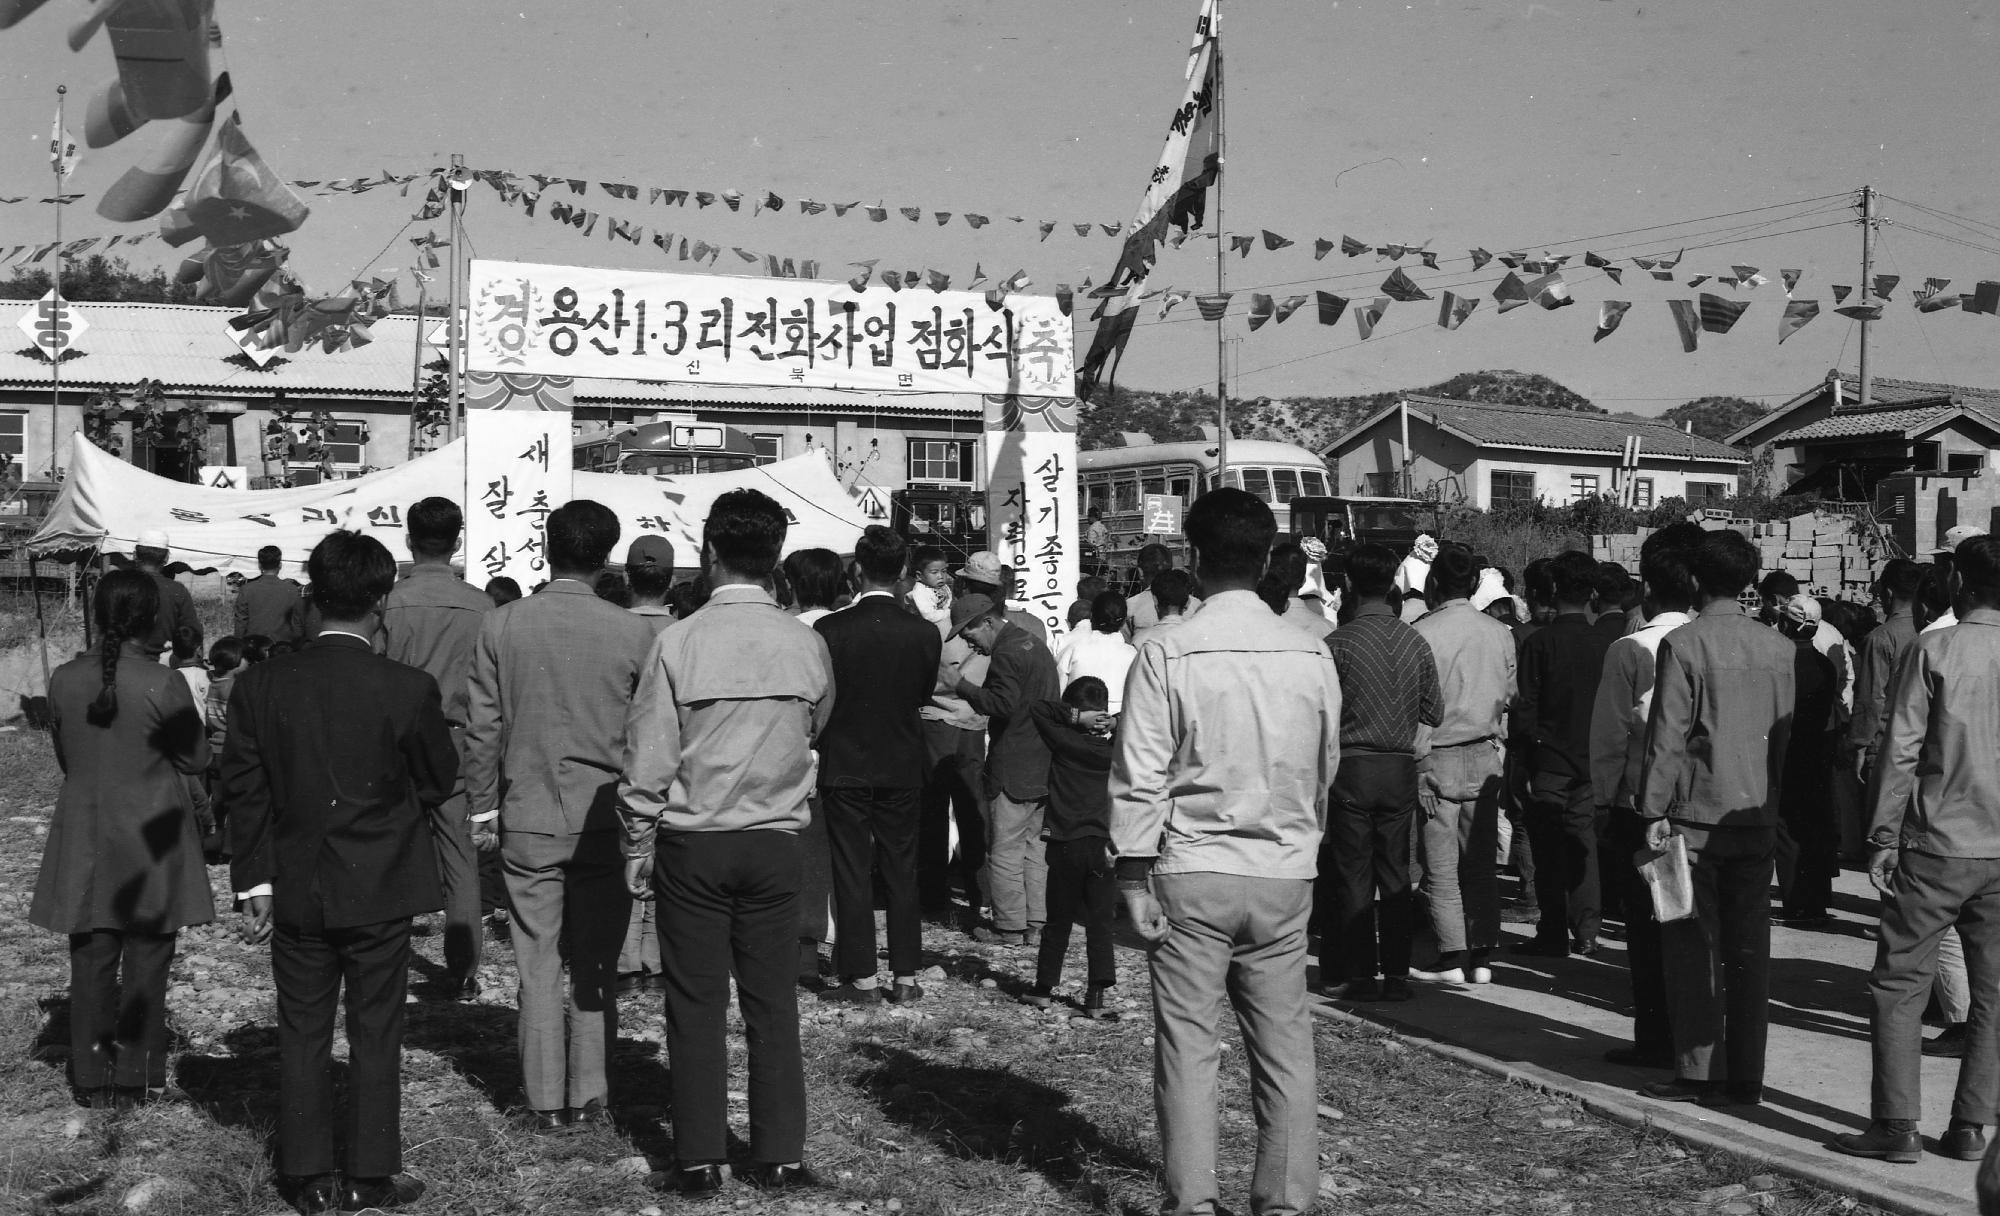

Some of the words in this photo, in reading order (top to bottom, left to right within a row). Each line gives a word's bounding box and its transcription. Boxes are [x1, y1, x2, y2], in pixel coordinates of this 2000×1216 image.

[907, 305, 1013, 379] 점화식
[1020, 320, 1064, 382] 축
[517, 433, 549, 473] 새
[515, 490, 551, 591] 춘성
